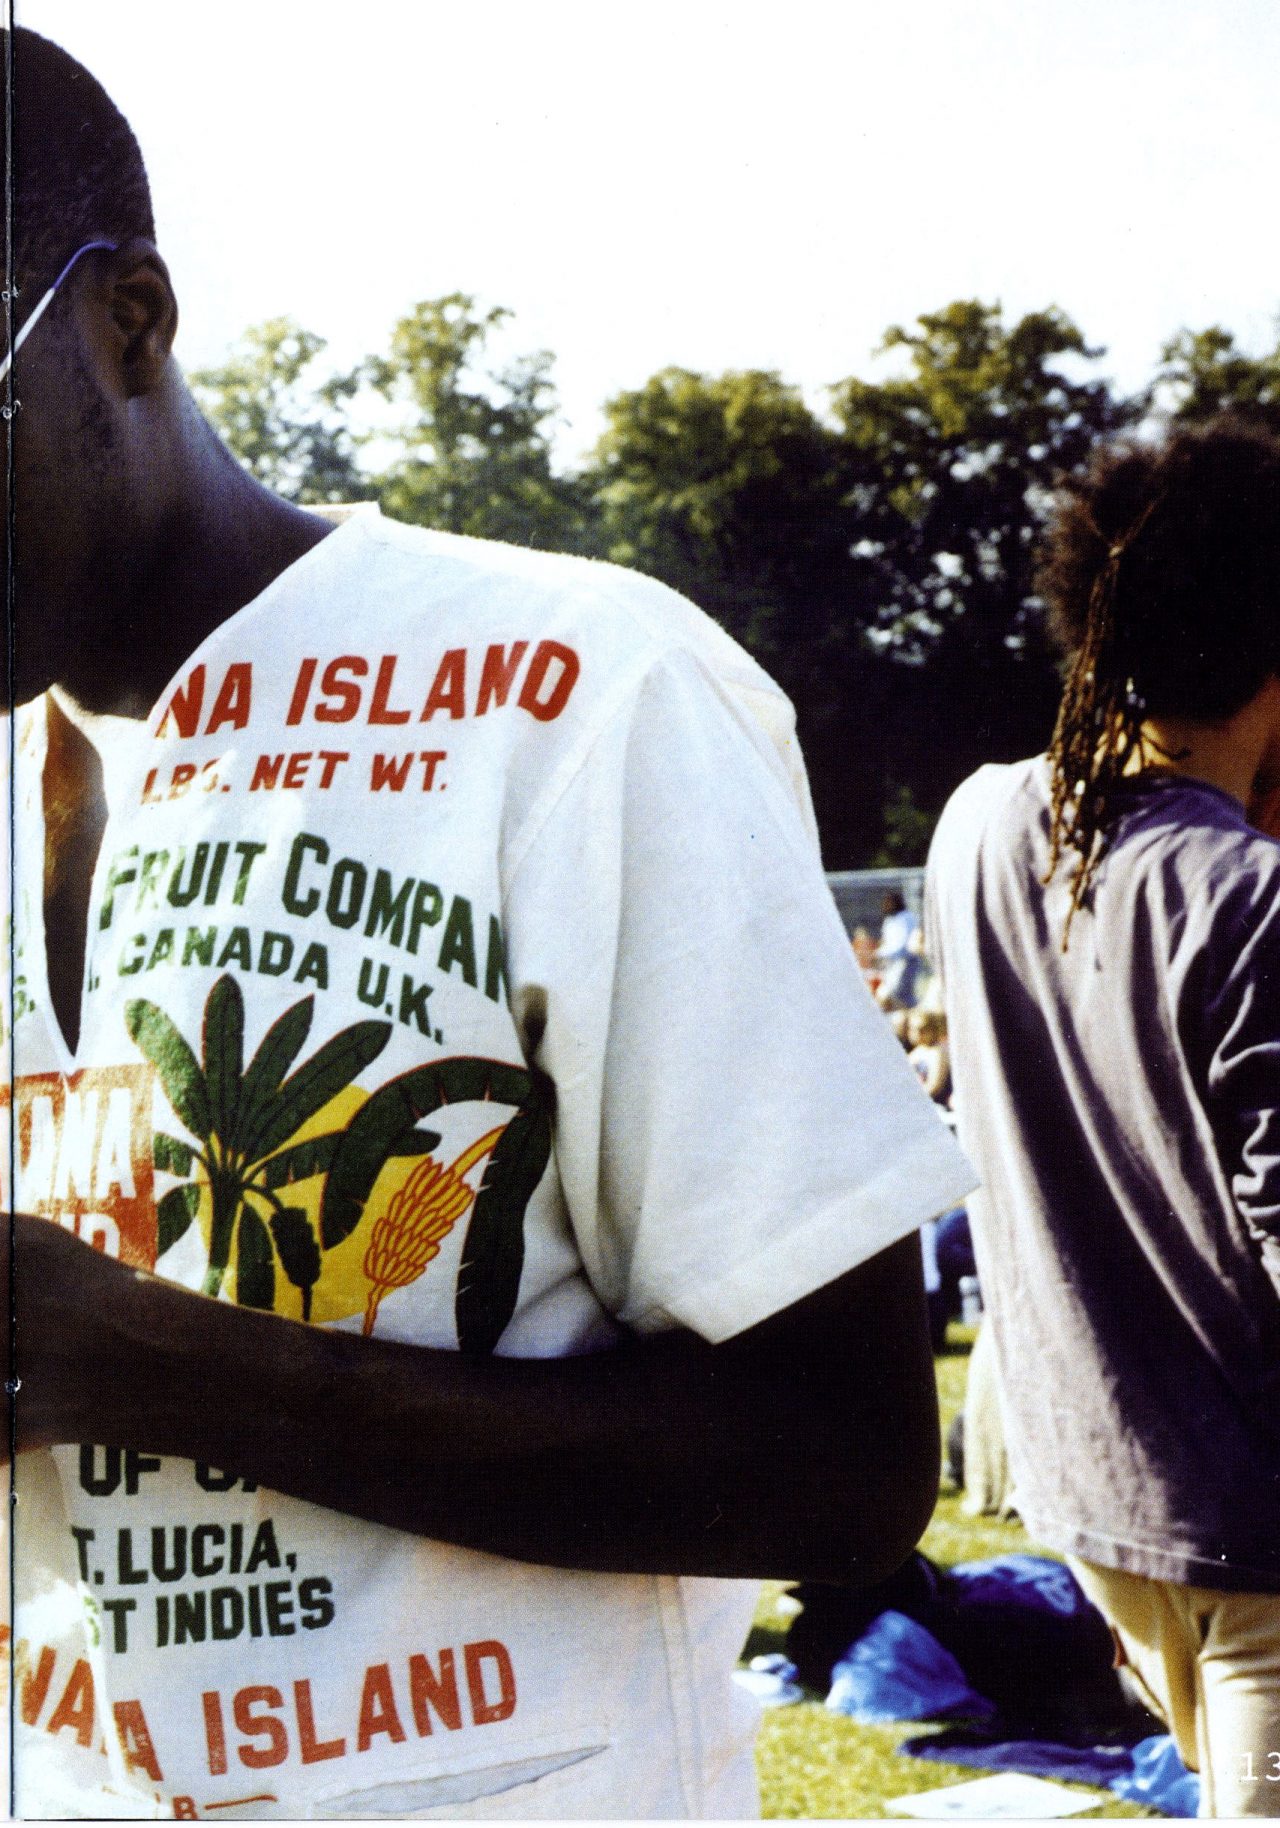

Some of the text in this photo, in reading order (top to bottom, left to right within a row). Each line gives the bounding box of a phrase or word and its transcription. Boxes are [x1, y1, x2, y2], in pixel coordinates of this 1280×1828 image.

[286, 639, 580, 726] ISLAND
[249, 751, 349, 791] NET
[370, 751, 447, 792] WT.
[99, 840, 267, 931] FRUIT
[118, 926, 329, 990] CANADA
[357, 955, 443, 1045] U.K.
[118, 1518, 297, 1585] LUCIA,
[156, 1576, 335, 1648] INDIES
[202, 1640, 518, 1776] ISLAND
